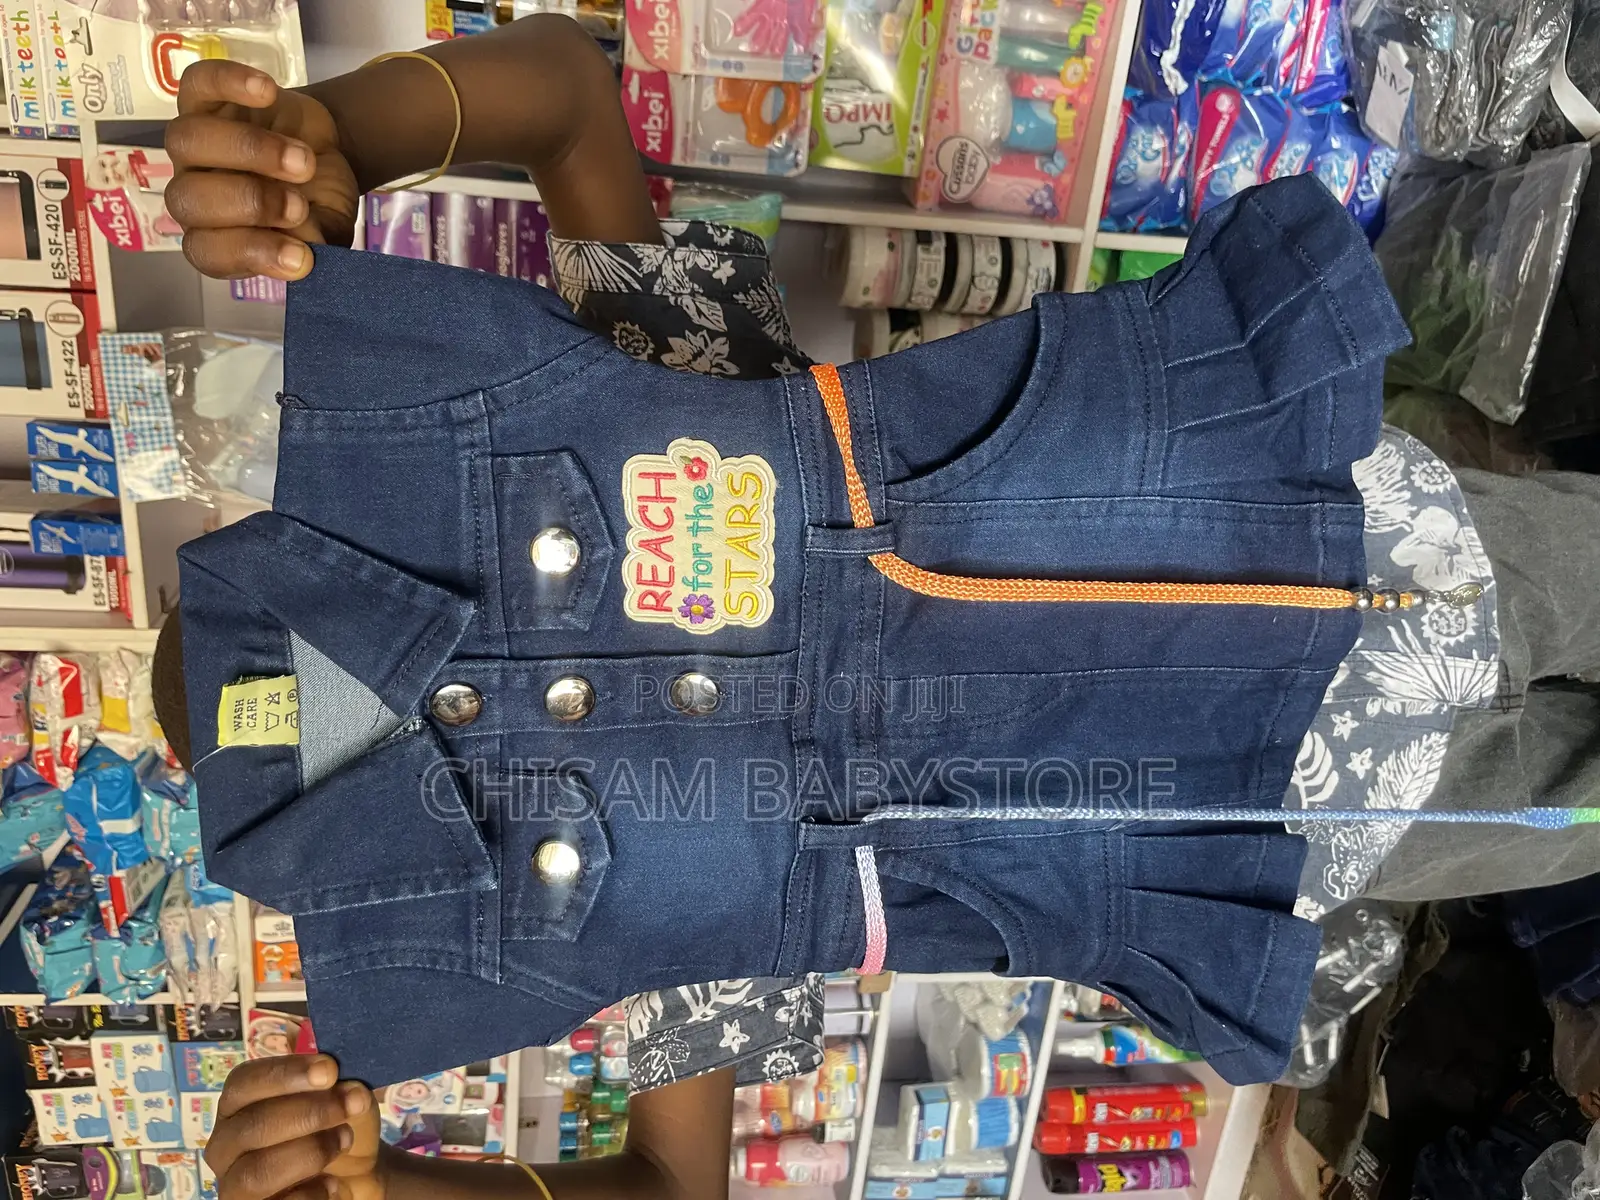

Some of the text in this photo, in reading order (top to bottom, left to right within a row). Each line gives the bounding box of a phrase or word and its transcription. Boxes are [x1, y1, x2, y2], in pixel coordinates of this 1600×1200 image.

[10, 10, 40, 120] milk teeth
[78, 62, 105, 113] Only
[56, 75, 77, 119] milk
[641, 90, 665, 153] xibei
[948, 140, 970, 195] Cussons
[44, 204, 67, 280] ES-SF-420
[102, 196, 133, 247] xibei
[66, 228, 81, 281] 2000ML
[61, 340, 80, 409] ES-SF-422
[636, 472, 677, 612] REACH
[681, 483, 714, 592] for the
[723, 471, 763, 619] STARS
[233, 698, 245, 731] WASH
[246, 697, 258, 728] CARE
[30, 1044, 49, 1081] HONEY
